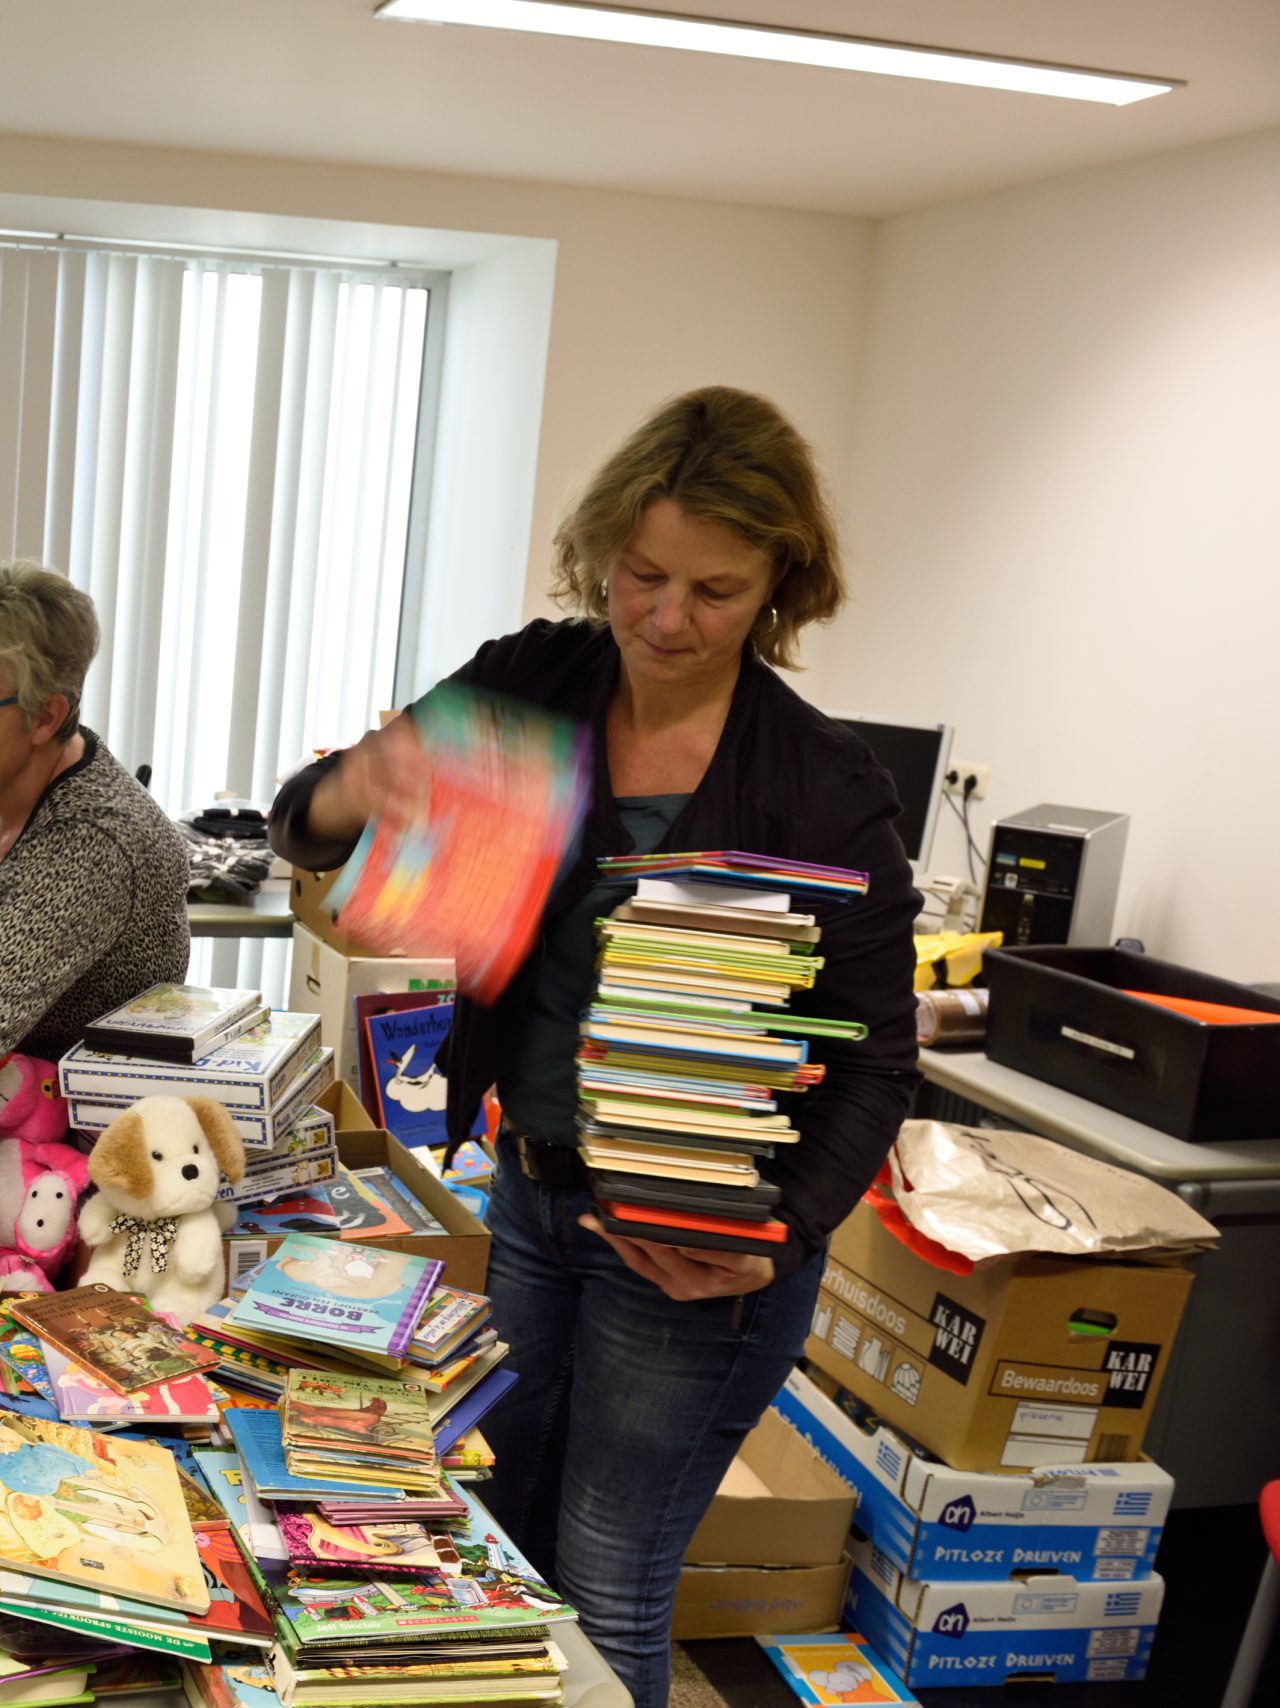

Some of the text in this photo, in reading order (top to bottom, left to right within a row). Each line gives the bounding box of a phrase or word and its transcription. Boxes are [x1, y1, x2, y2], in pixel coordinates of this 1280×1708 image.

[279, 1296, 363, 1322] BORRE
[821, 1267, 906, 1335] erhuisdoos
[934, 1303, 977, 1346] KAR
[935, 1329, 973, 1365] WEI
[1106, 1350, 1152, 1373] KAR
[1001, 1369, 1099, 1397] Bewaardoos
[1108, 1371, 1148, 1392] WEI
[934, 1546, 1082, 1564] PITLOZE DRUIVEN
[407, 1615, 478, 1626] SCHOLASTIC
[113, 1623, 163, 1643] MOOISTE
[164, 1636, 180, 1647] DE
[928, 1652, 1076, 1670] PITLOZE DRUIVEN
